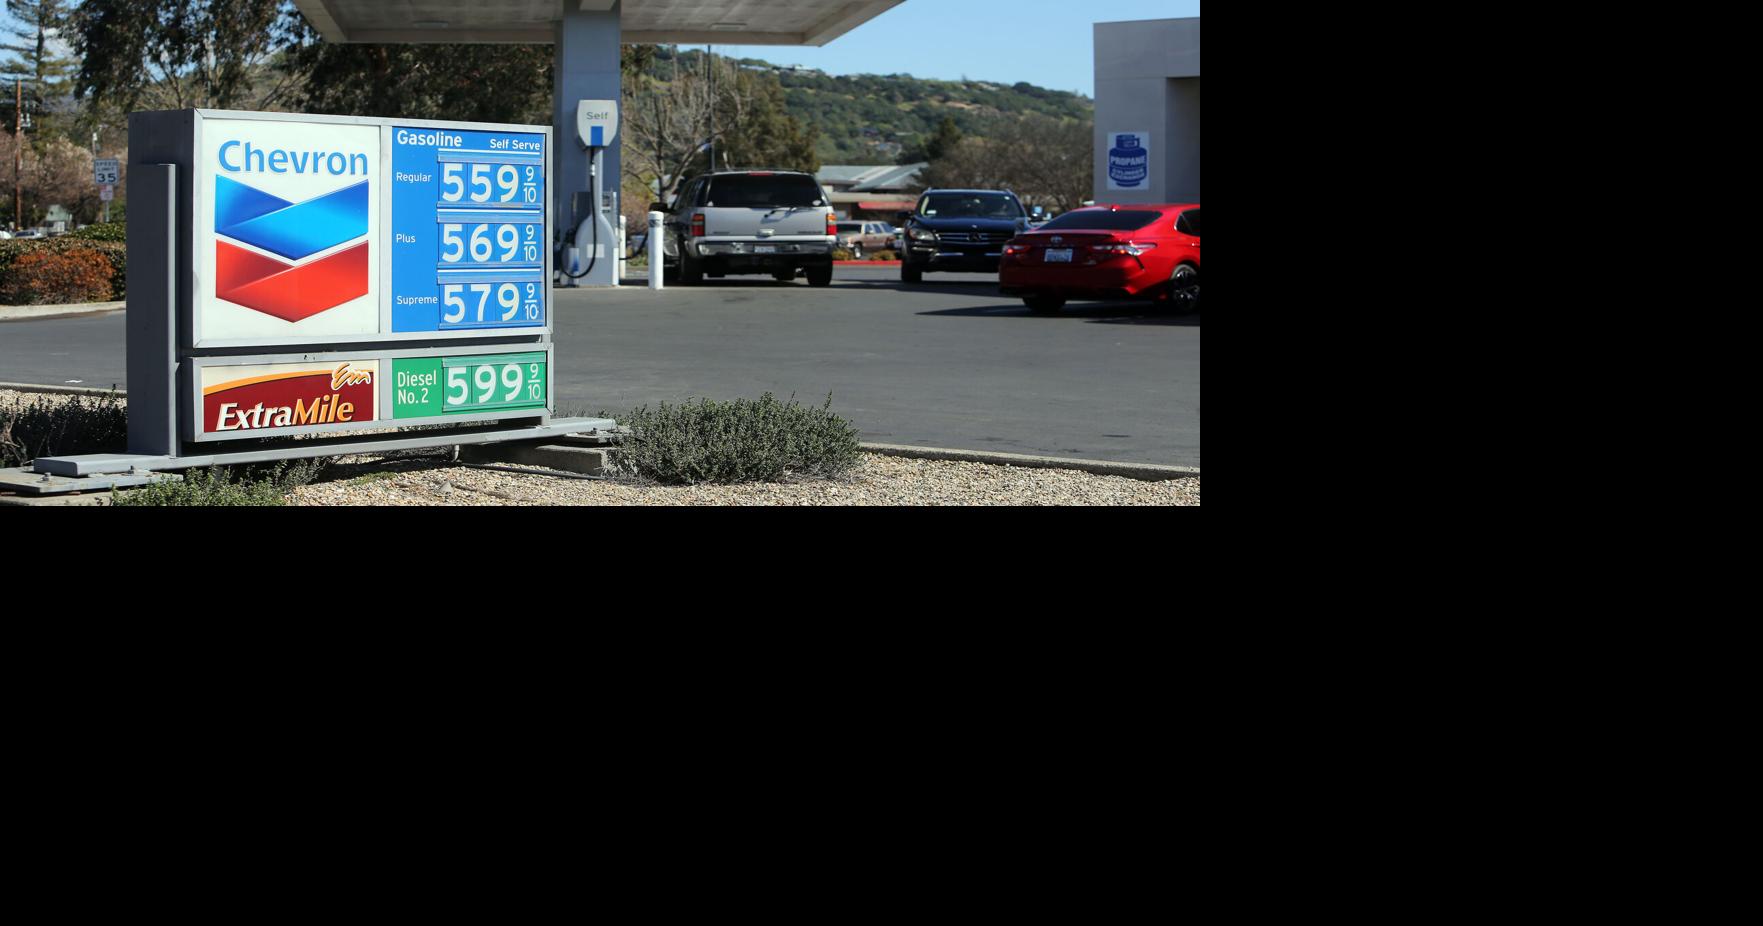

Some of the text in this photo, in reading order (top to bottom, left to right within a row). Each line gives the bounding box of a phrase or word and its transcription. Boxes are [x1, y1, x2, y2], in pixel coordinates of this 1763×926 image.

[586, 111, 608, 120] Self
[397, 130, 462, 147] Gasoline
[490, 138, 540, 150] Self Serve
[218, 140, 368, 175] Chevron
[1110, 155, 1146, 167] PROPANE
[97, 173, 117, 183] 35
[525, 166, 535, 181] 9
[396, 162, 519, 203] Regular 559
[523, 187, 537, 203] 10
[525, 224, 535, 240] 9
[396, 223, 519, 263] Plus 569
[524, 245, 537, 261] 10
[526, 283, 535, 299] 9
[396, 283, 520, 323] Supreme 579
[525, 304, 538, 320] 10
[530, 363, 539, 379] 9
[397, 364, 523, 405] Diesel 599
[528, 384, 541, 400] 10
[215, 394, 354, 432] ExtraMile
